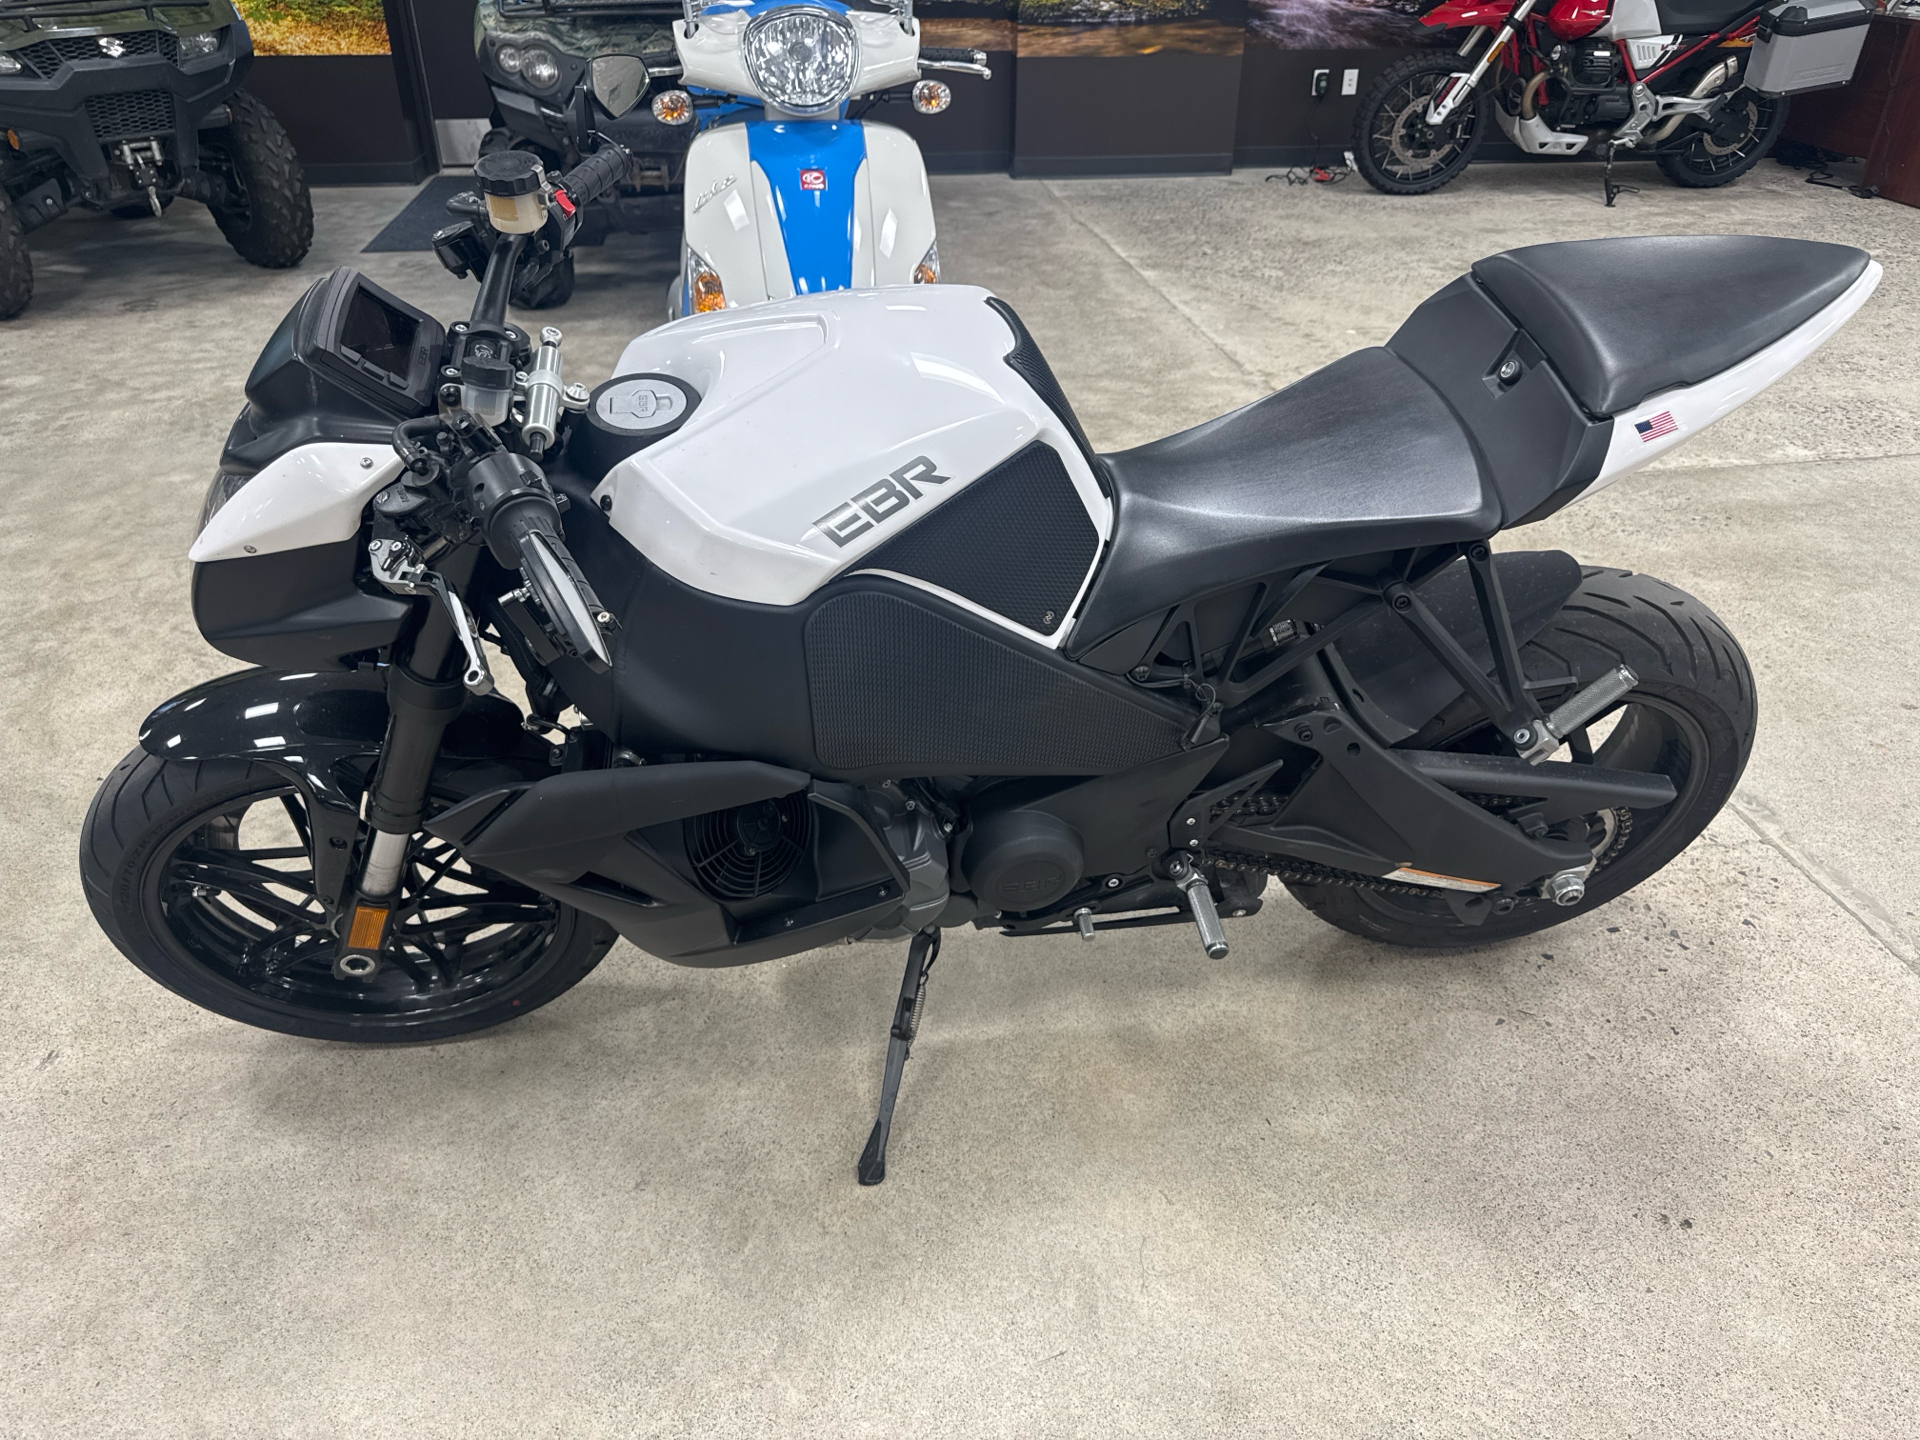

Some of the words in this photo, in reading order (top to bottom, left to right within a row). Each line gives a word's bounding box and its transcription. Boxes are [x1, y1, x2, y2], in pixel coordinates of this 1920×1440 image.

[418, 346, 429, 367] EBR
[814, 456, 950, 546] EBR
[998, 875, 1061, 892] EBR
